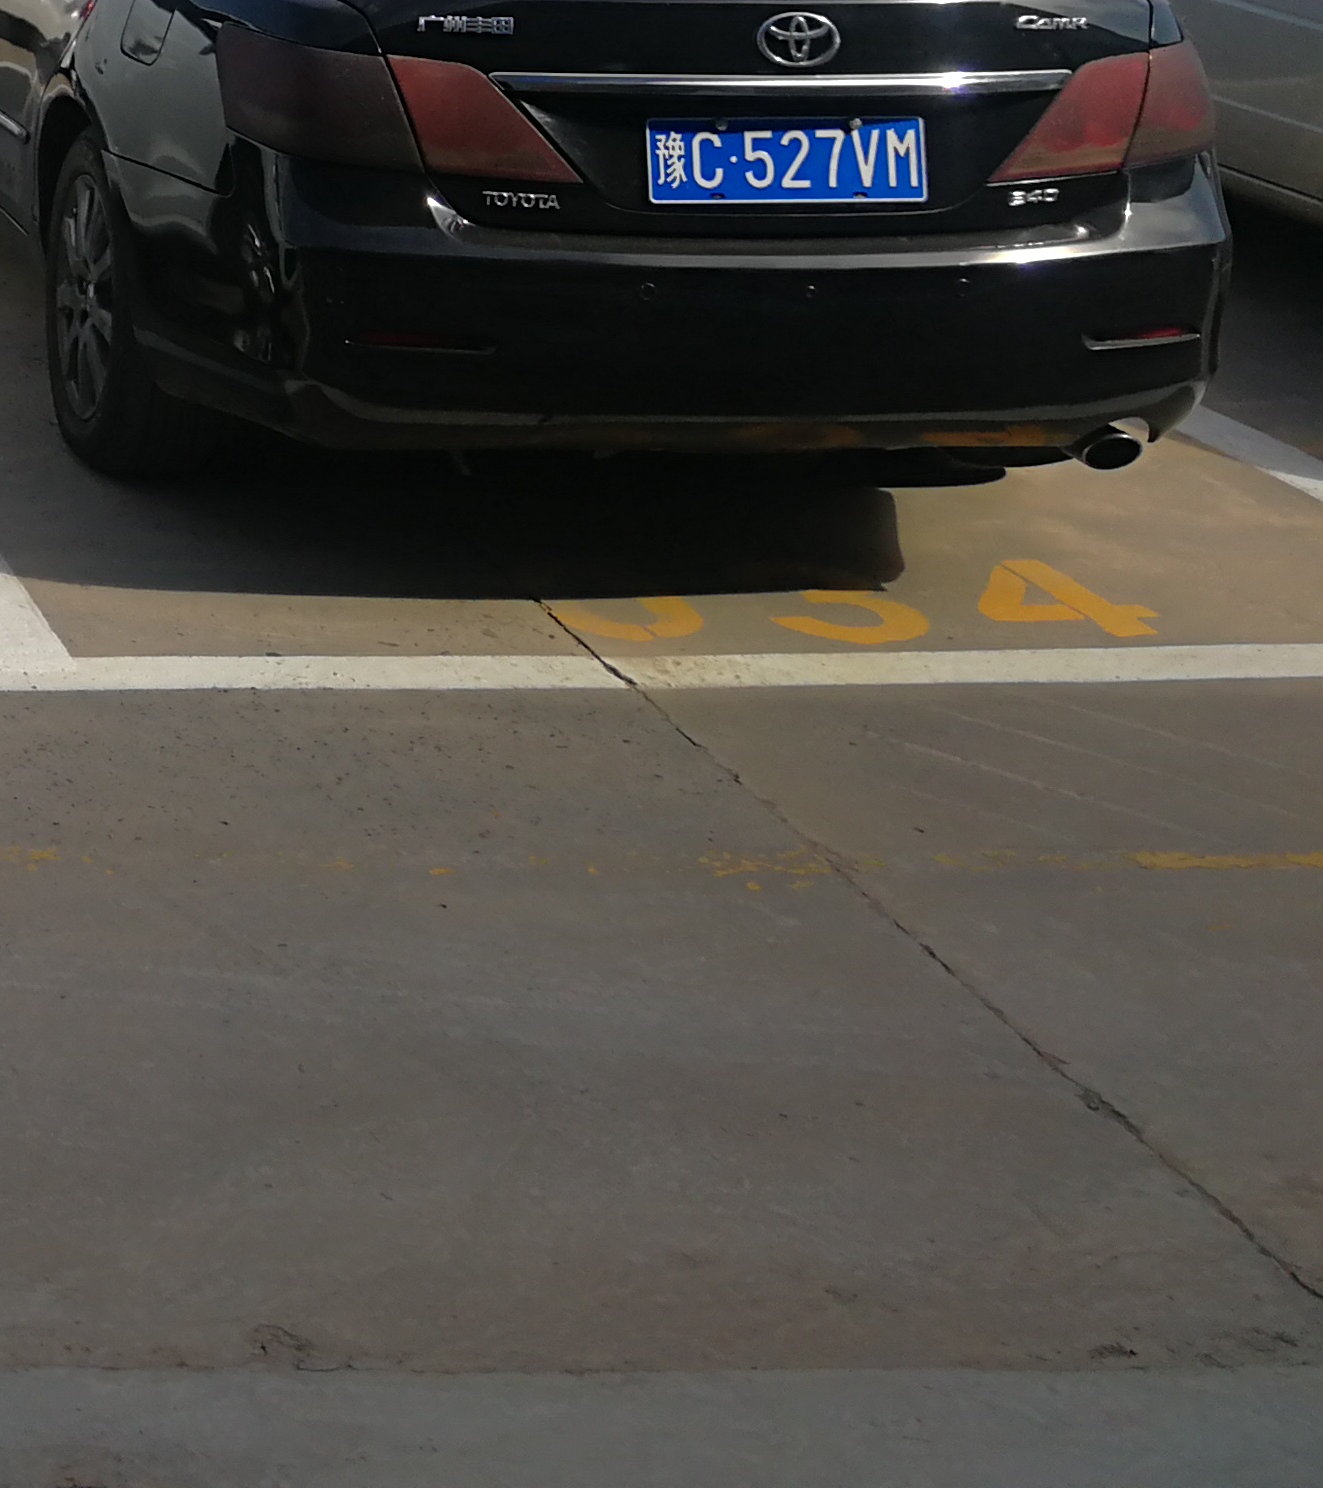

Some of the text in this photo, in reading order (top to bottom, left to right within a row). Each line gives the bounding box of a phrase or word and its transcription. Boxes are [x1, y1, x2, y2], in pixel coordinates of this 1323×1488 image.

[417, 15, 515, 35] 广州丰田
[654, 125, 923, 192] 豫C·527VM
[482, 190, 561, 210] TOYOTA
